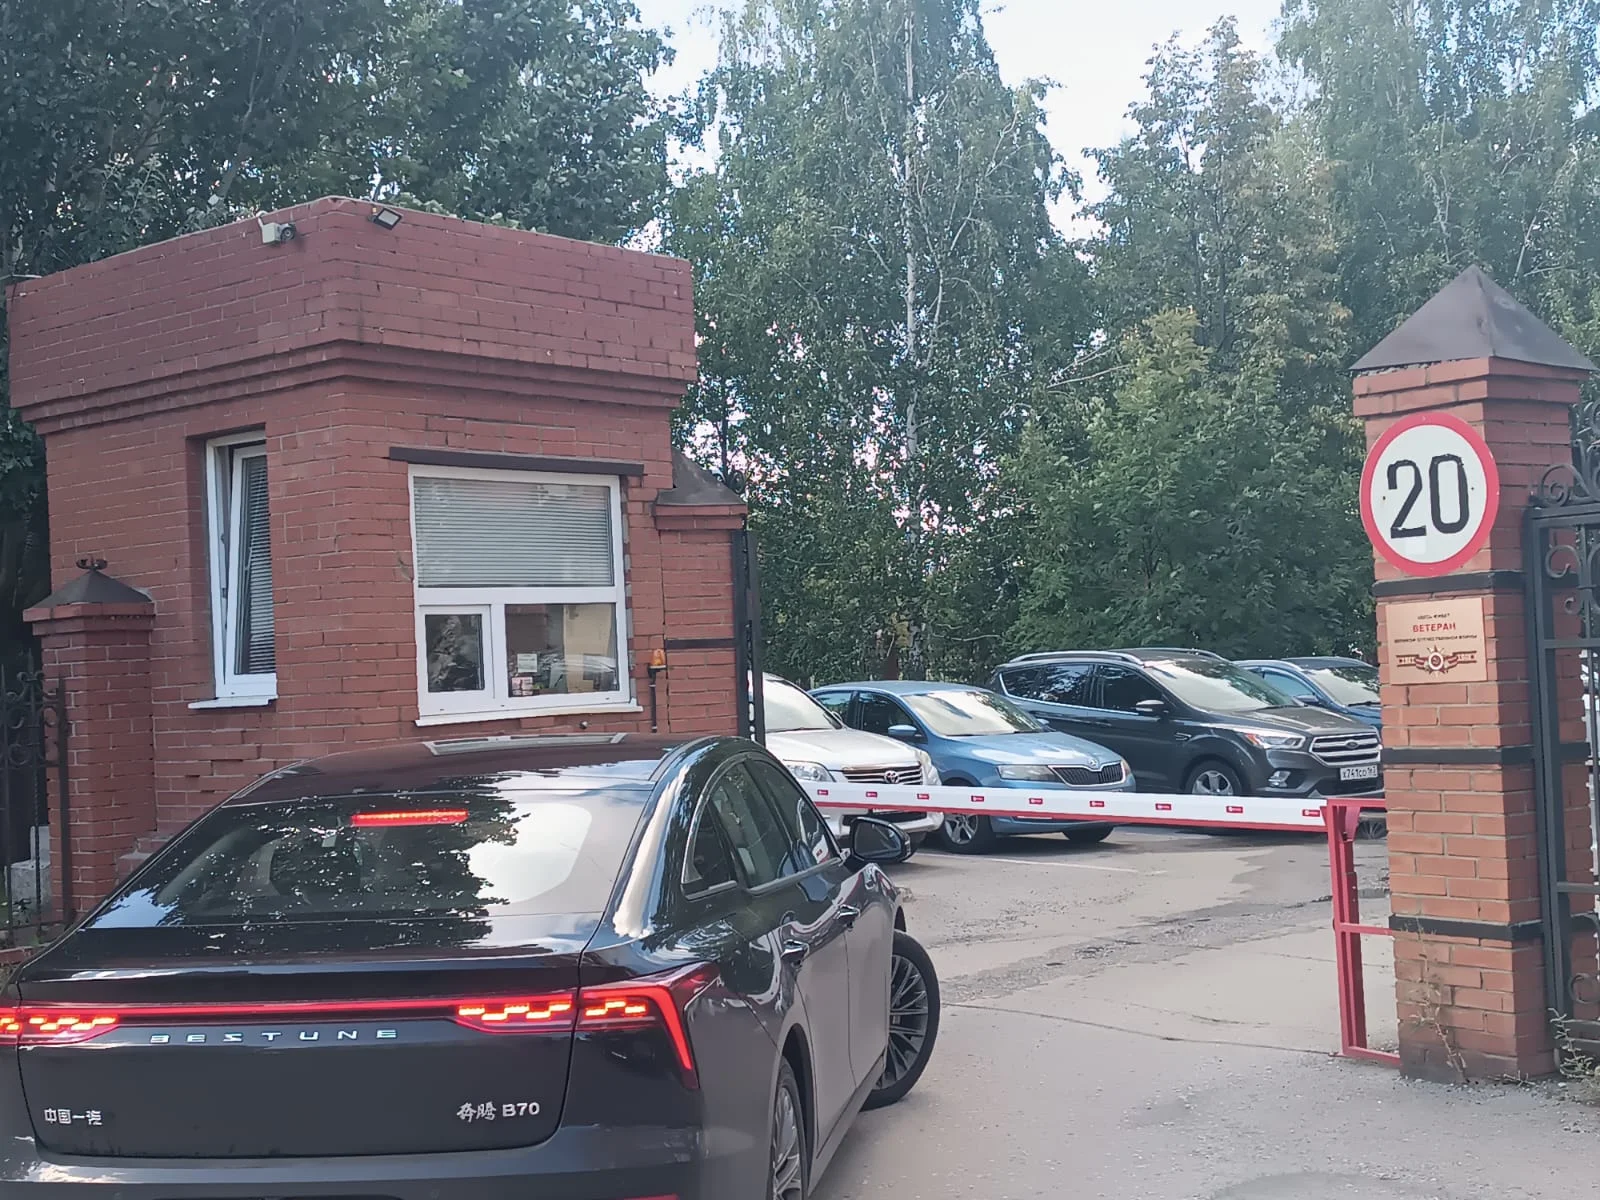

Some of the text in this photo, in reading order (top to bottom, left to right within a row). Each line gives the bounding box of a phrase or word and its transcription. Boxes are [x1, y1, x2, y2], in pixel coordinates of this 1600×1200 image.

[1386, 453, 1470, 539] 20
[1412, 622, 1457, 633] ВЕТЕРАН
[150, 1029, 398, 1044] BESTUNE
[44, 1108, 103, 1126] 中国一汽
[502, 1102, 541, 1117] B70
